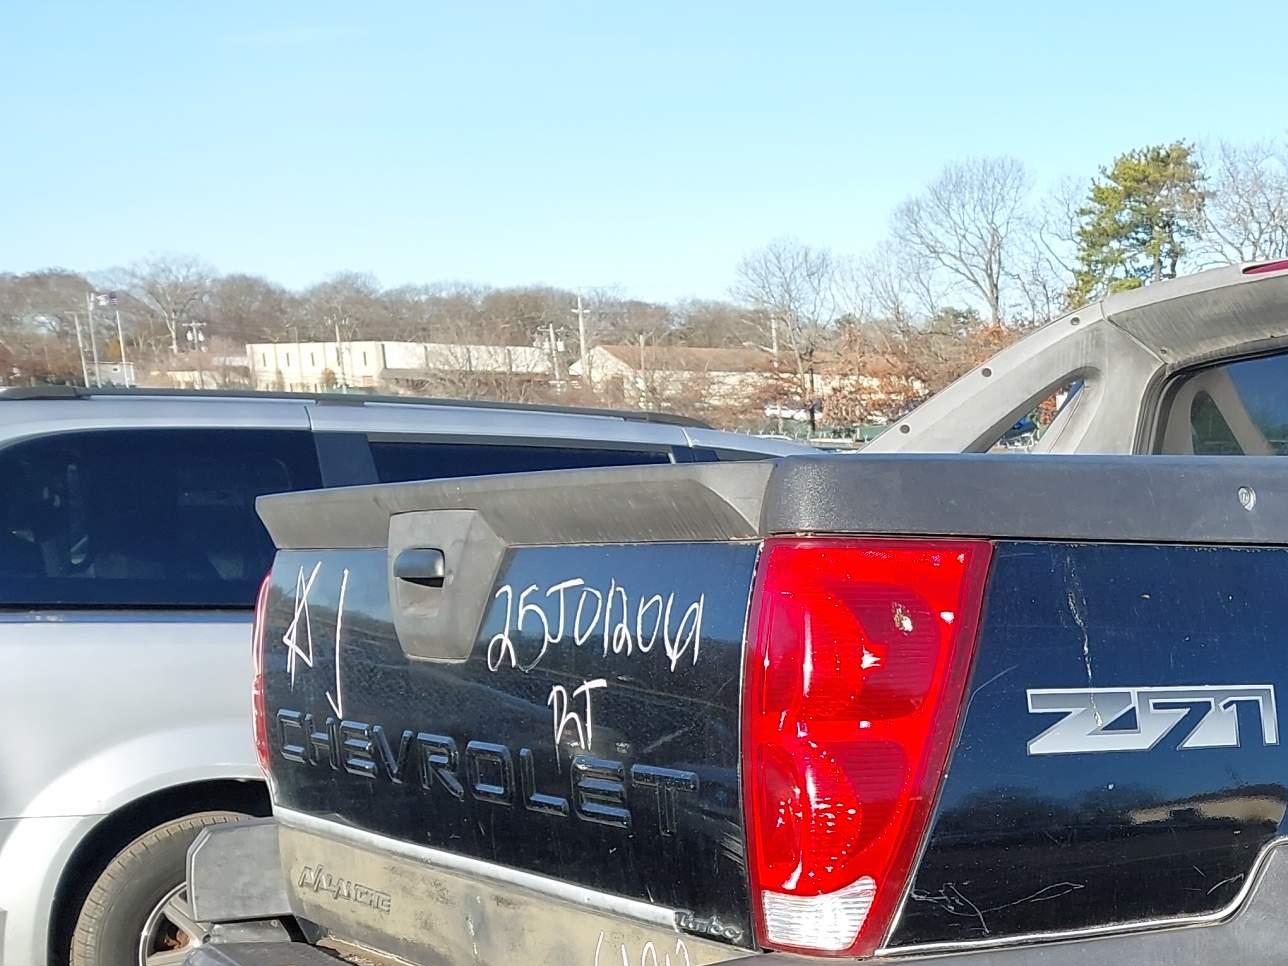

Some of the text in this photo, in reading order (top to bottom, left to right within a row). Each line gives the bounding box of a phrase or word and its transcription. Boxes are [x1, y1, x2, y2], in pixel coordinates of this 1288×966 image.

[548, 678, 608, 775] RT
[1026, 684, 1280, 756] Z71
[276, 708, 700, 838] CHEVROLET
[298, 863, 392, 915] AVALANCHE
